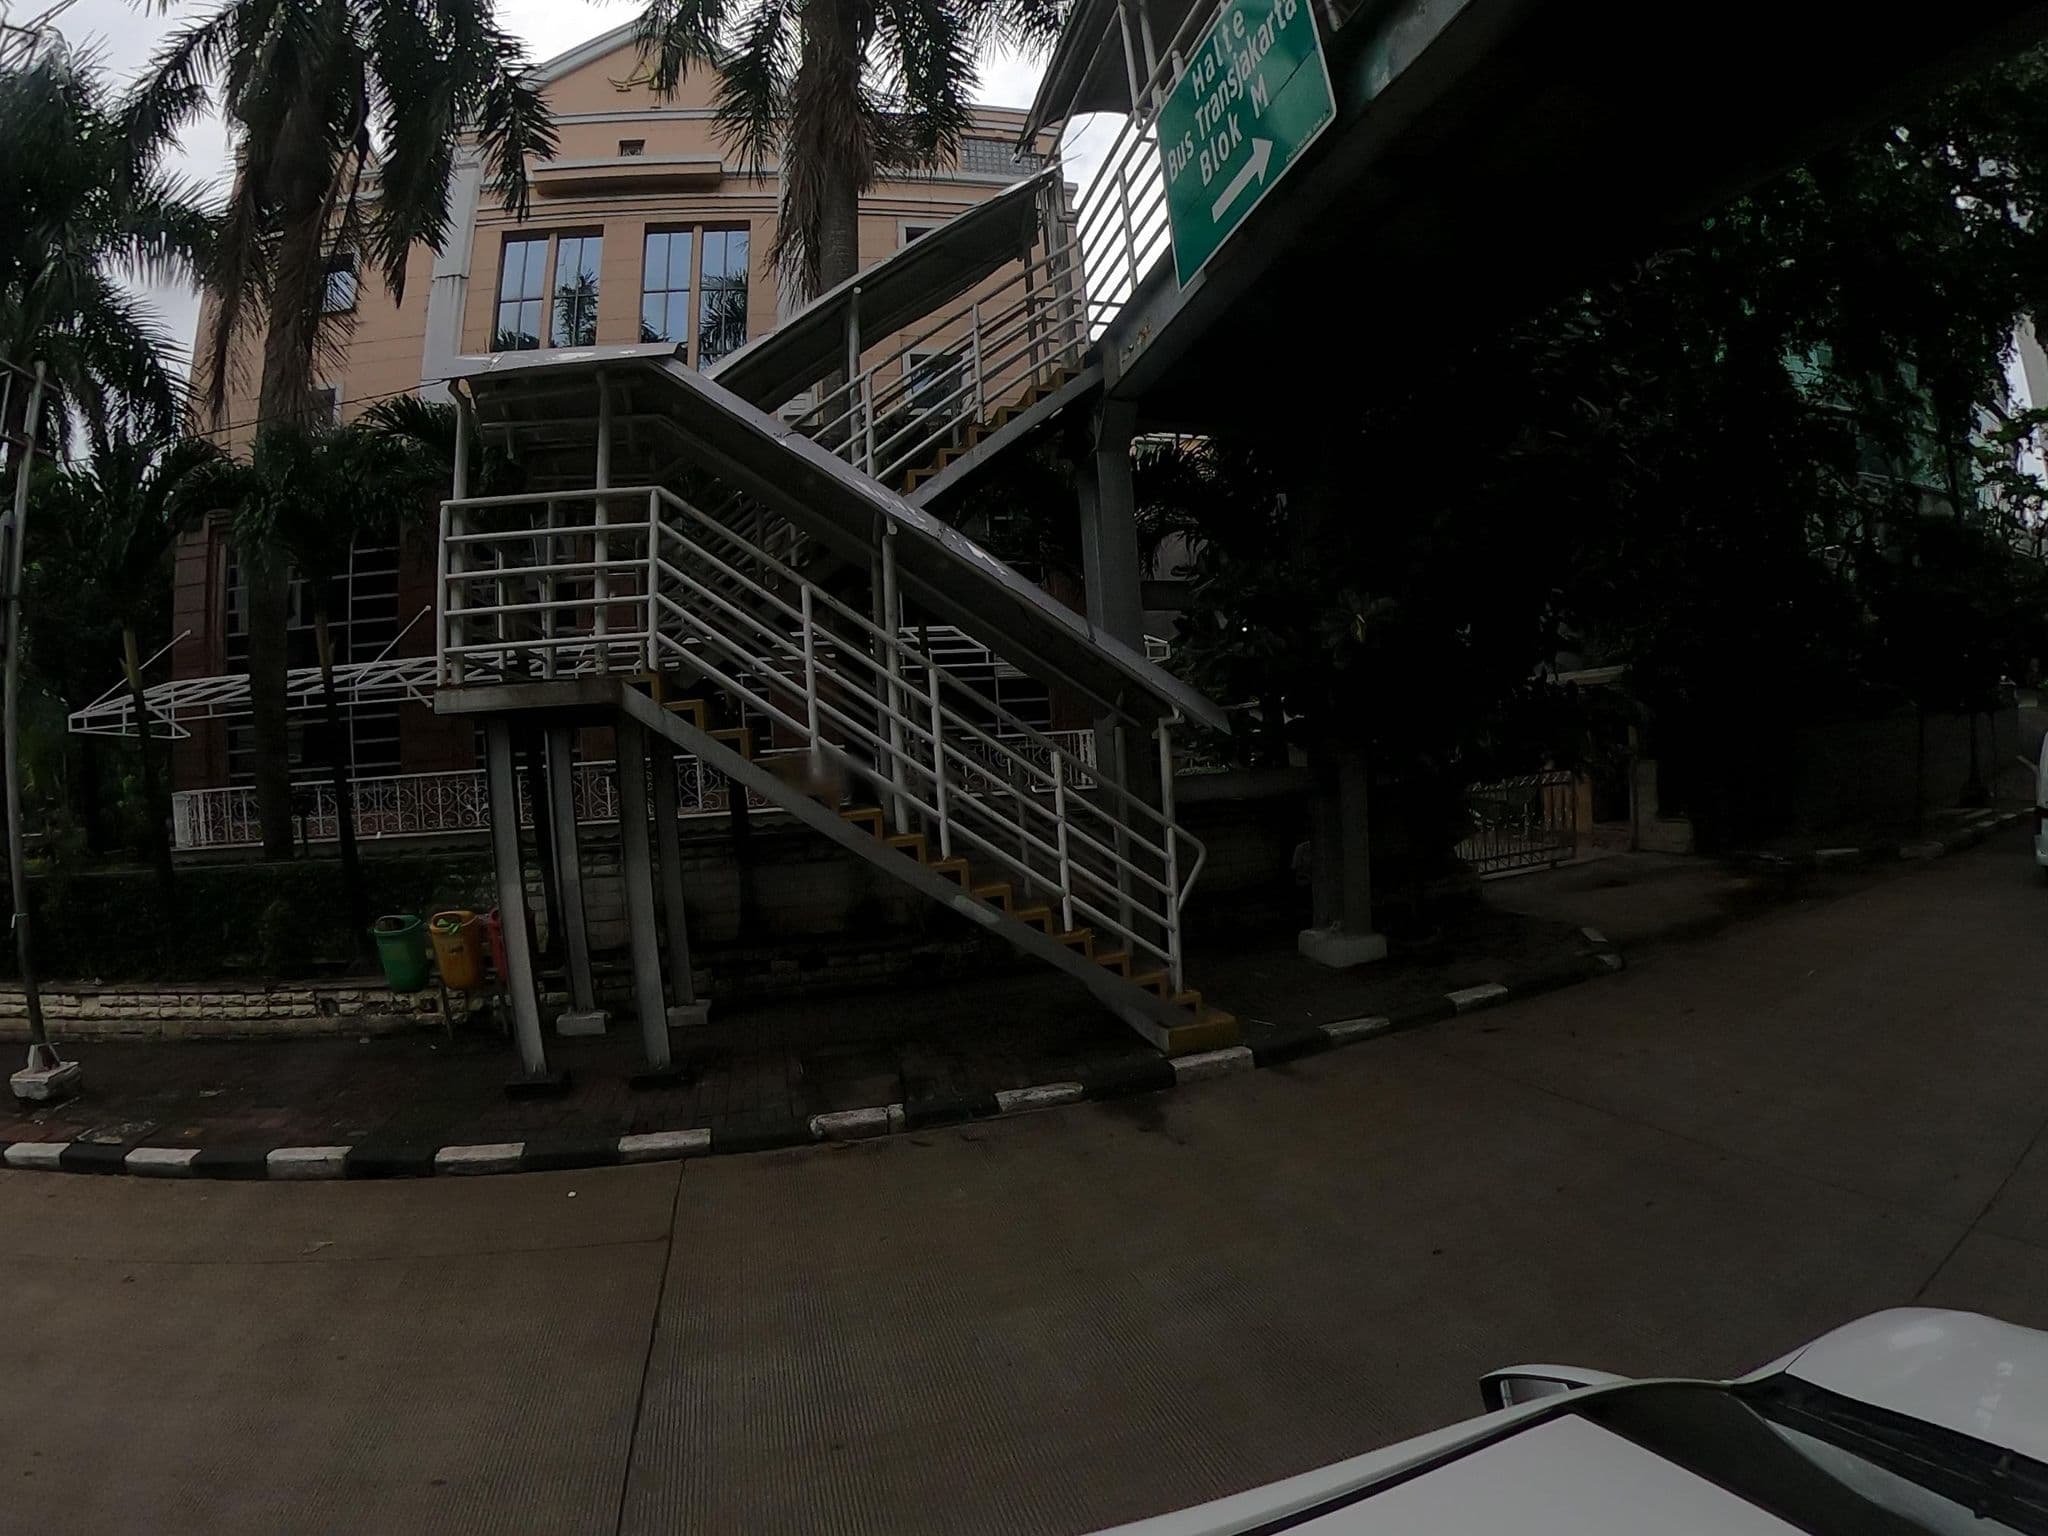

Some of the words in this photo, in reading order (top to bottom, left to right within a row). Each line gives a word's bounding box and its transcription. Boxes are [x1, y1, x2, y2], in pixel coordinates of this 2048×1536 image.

[1167, 130, 1195, 185] Bus
[1195, 0, 1297, 139] Transjakarta
[1191, 10, 1245, 100] Halte
[1199, 111, 1243, 187] Blok
[1250, 73, 1269, 119] M
